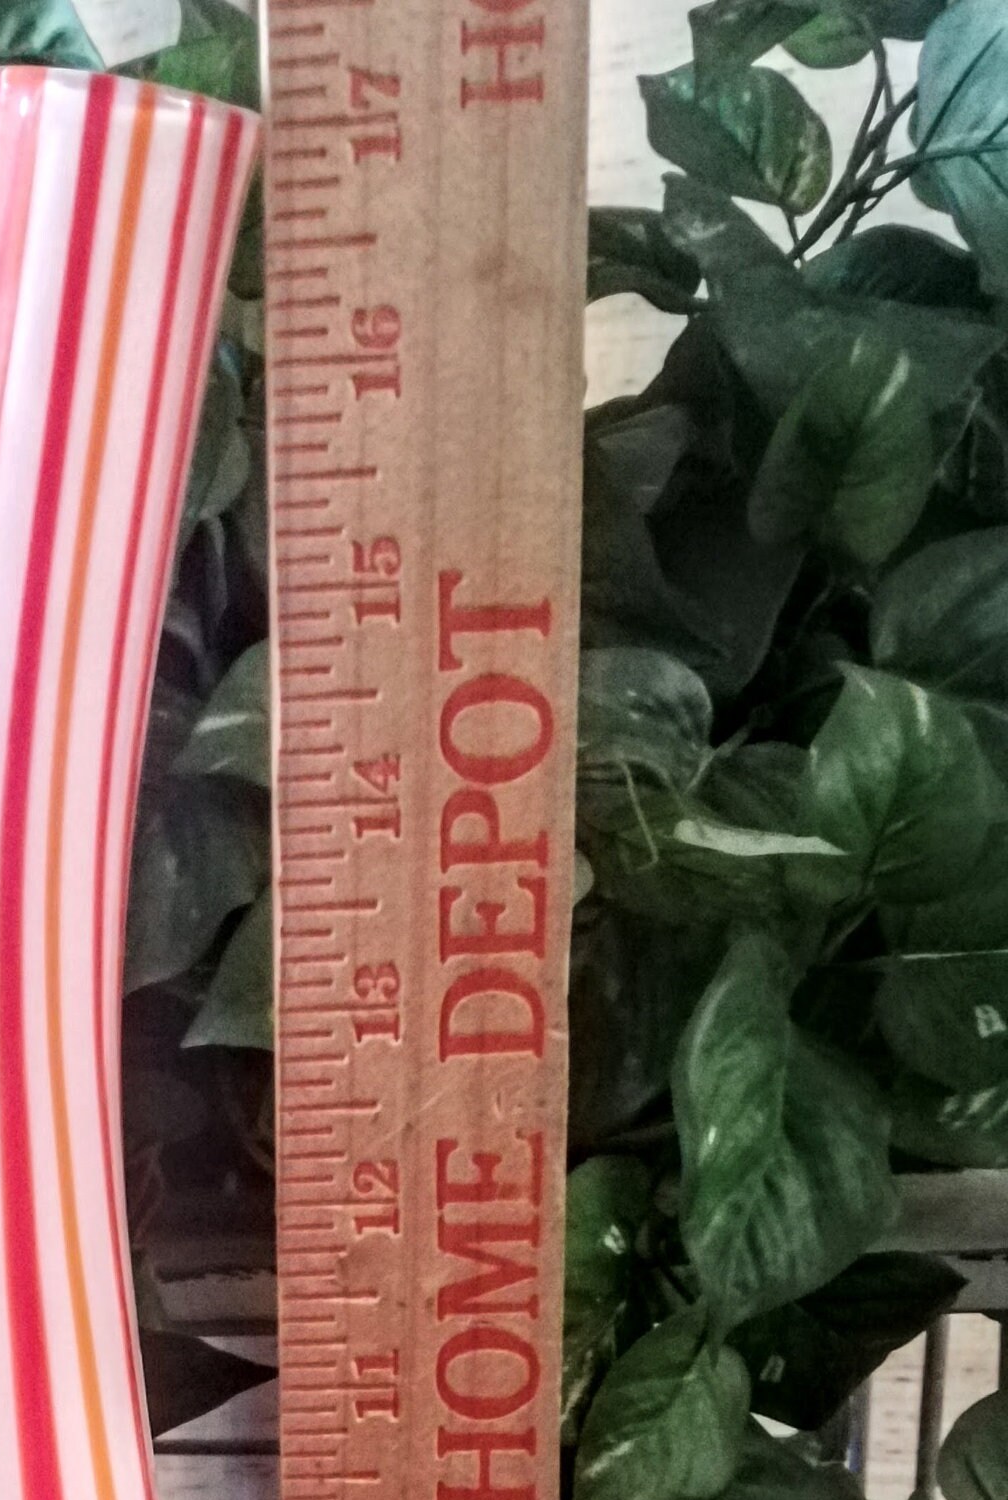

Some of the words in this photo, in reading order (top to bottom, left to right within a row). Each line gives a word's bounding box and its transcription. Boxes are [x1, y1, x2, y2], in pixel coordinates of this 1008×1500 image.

[460, 0, 545, 109] H
[349, 65, 403, 163] 17
[349, 303, 402, 401] 16
[352, 534, 402, 627] 15
[353, 754, 401, 839] 14
[437, 568, 553, 1063] DEPOT
[353, 961, 401, 1045] 13
[353, 1159, 400, 1236] 12
[355, 1347, 400, 1422] 11
